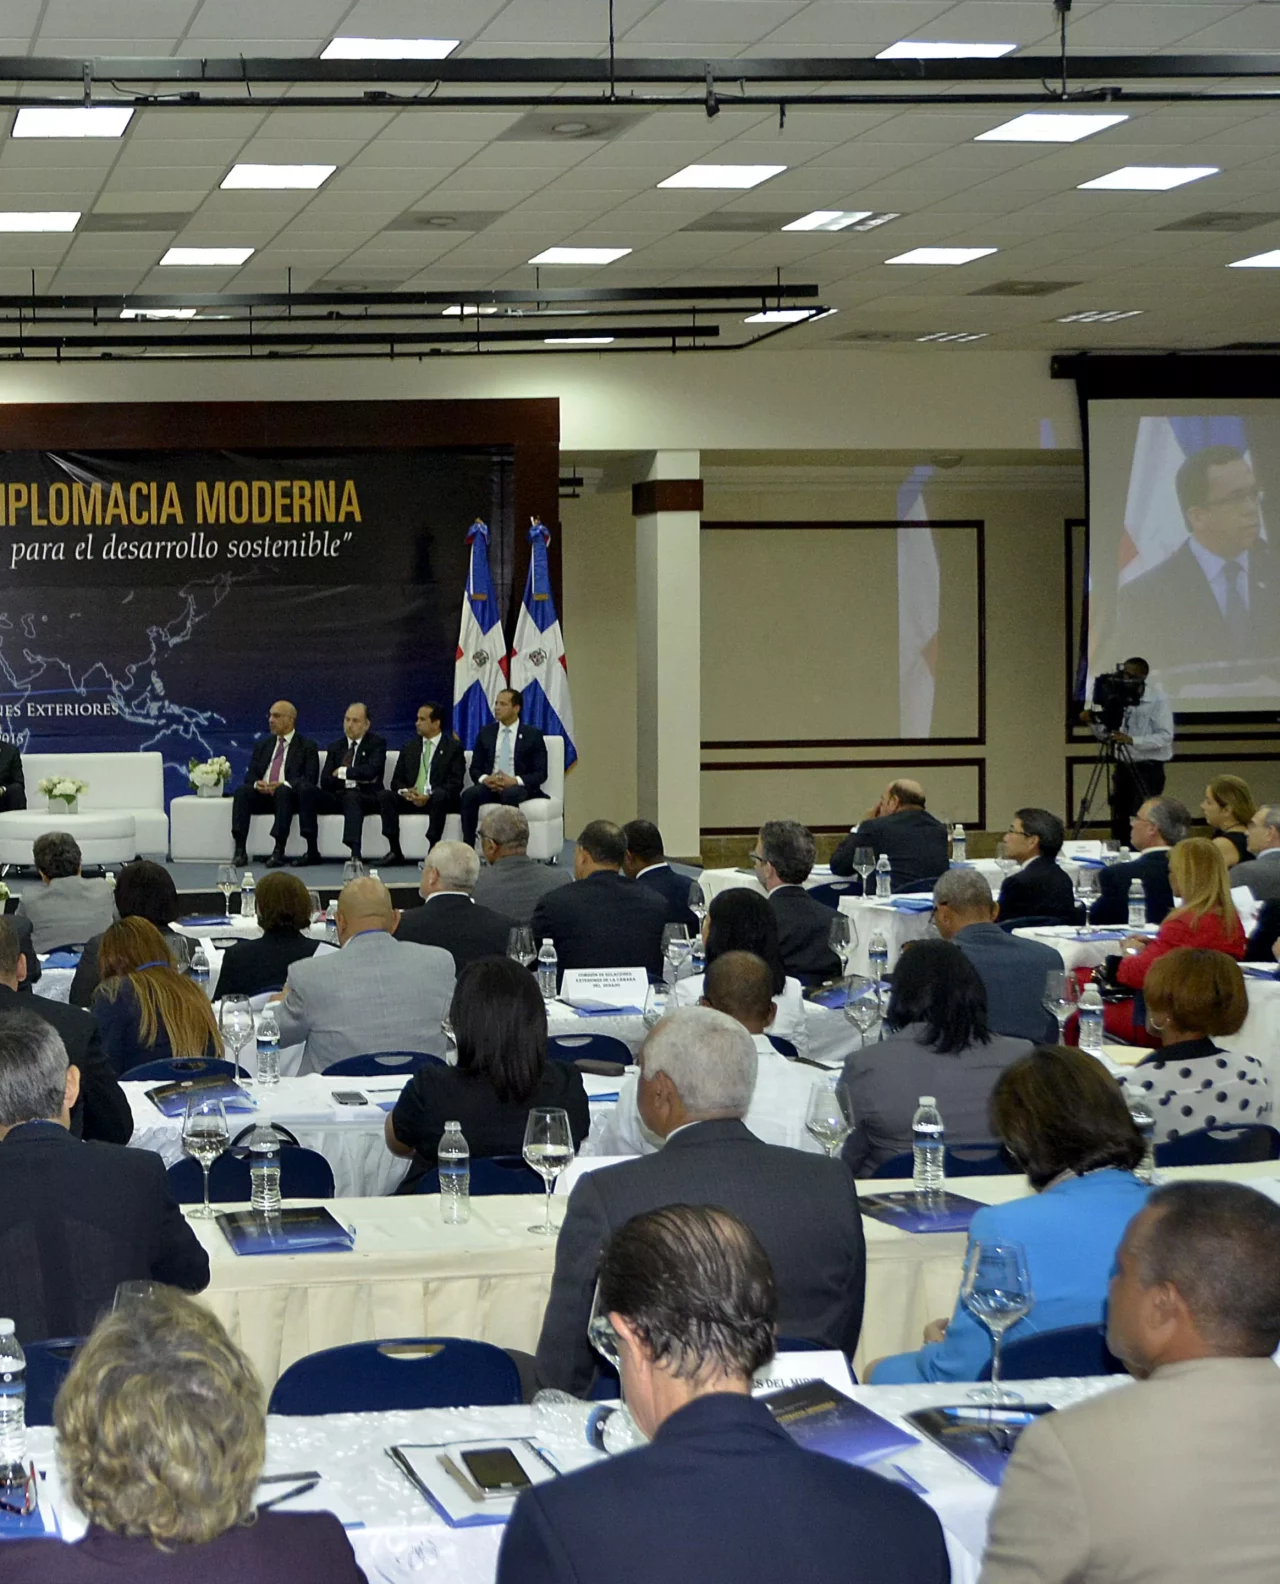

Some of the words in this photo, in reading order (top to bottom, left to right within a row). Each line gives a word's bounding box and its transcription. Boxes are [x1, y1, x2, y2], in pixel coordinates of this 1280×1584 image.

[196, 480, 362, 525] MODERNA
[9, 539, 65, 570] para
[74, 533, 94, 560] el
[102, 533, 219, 560] desarrollo
[27, 702, 119, 717] EXTERIORES
